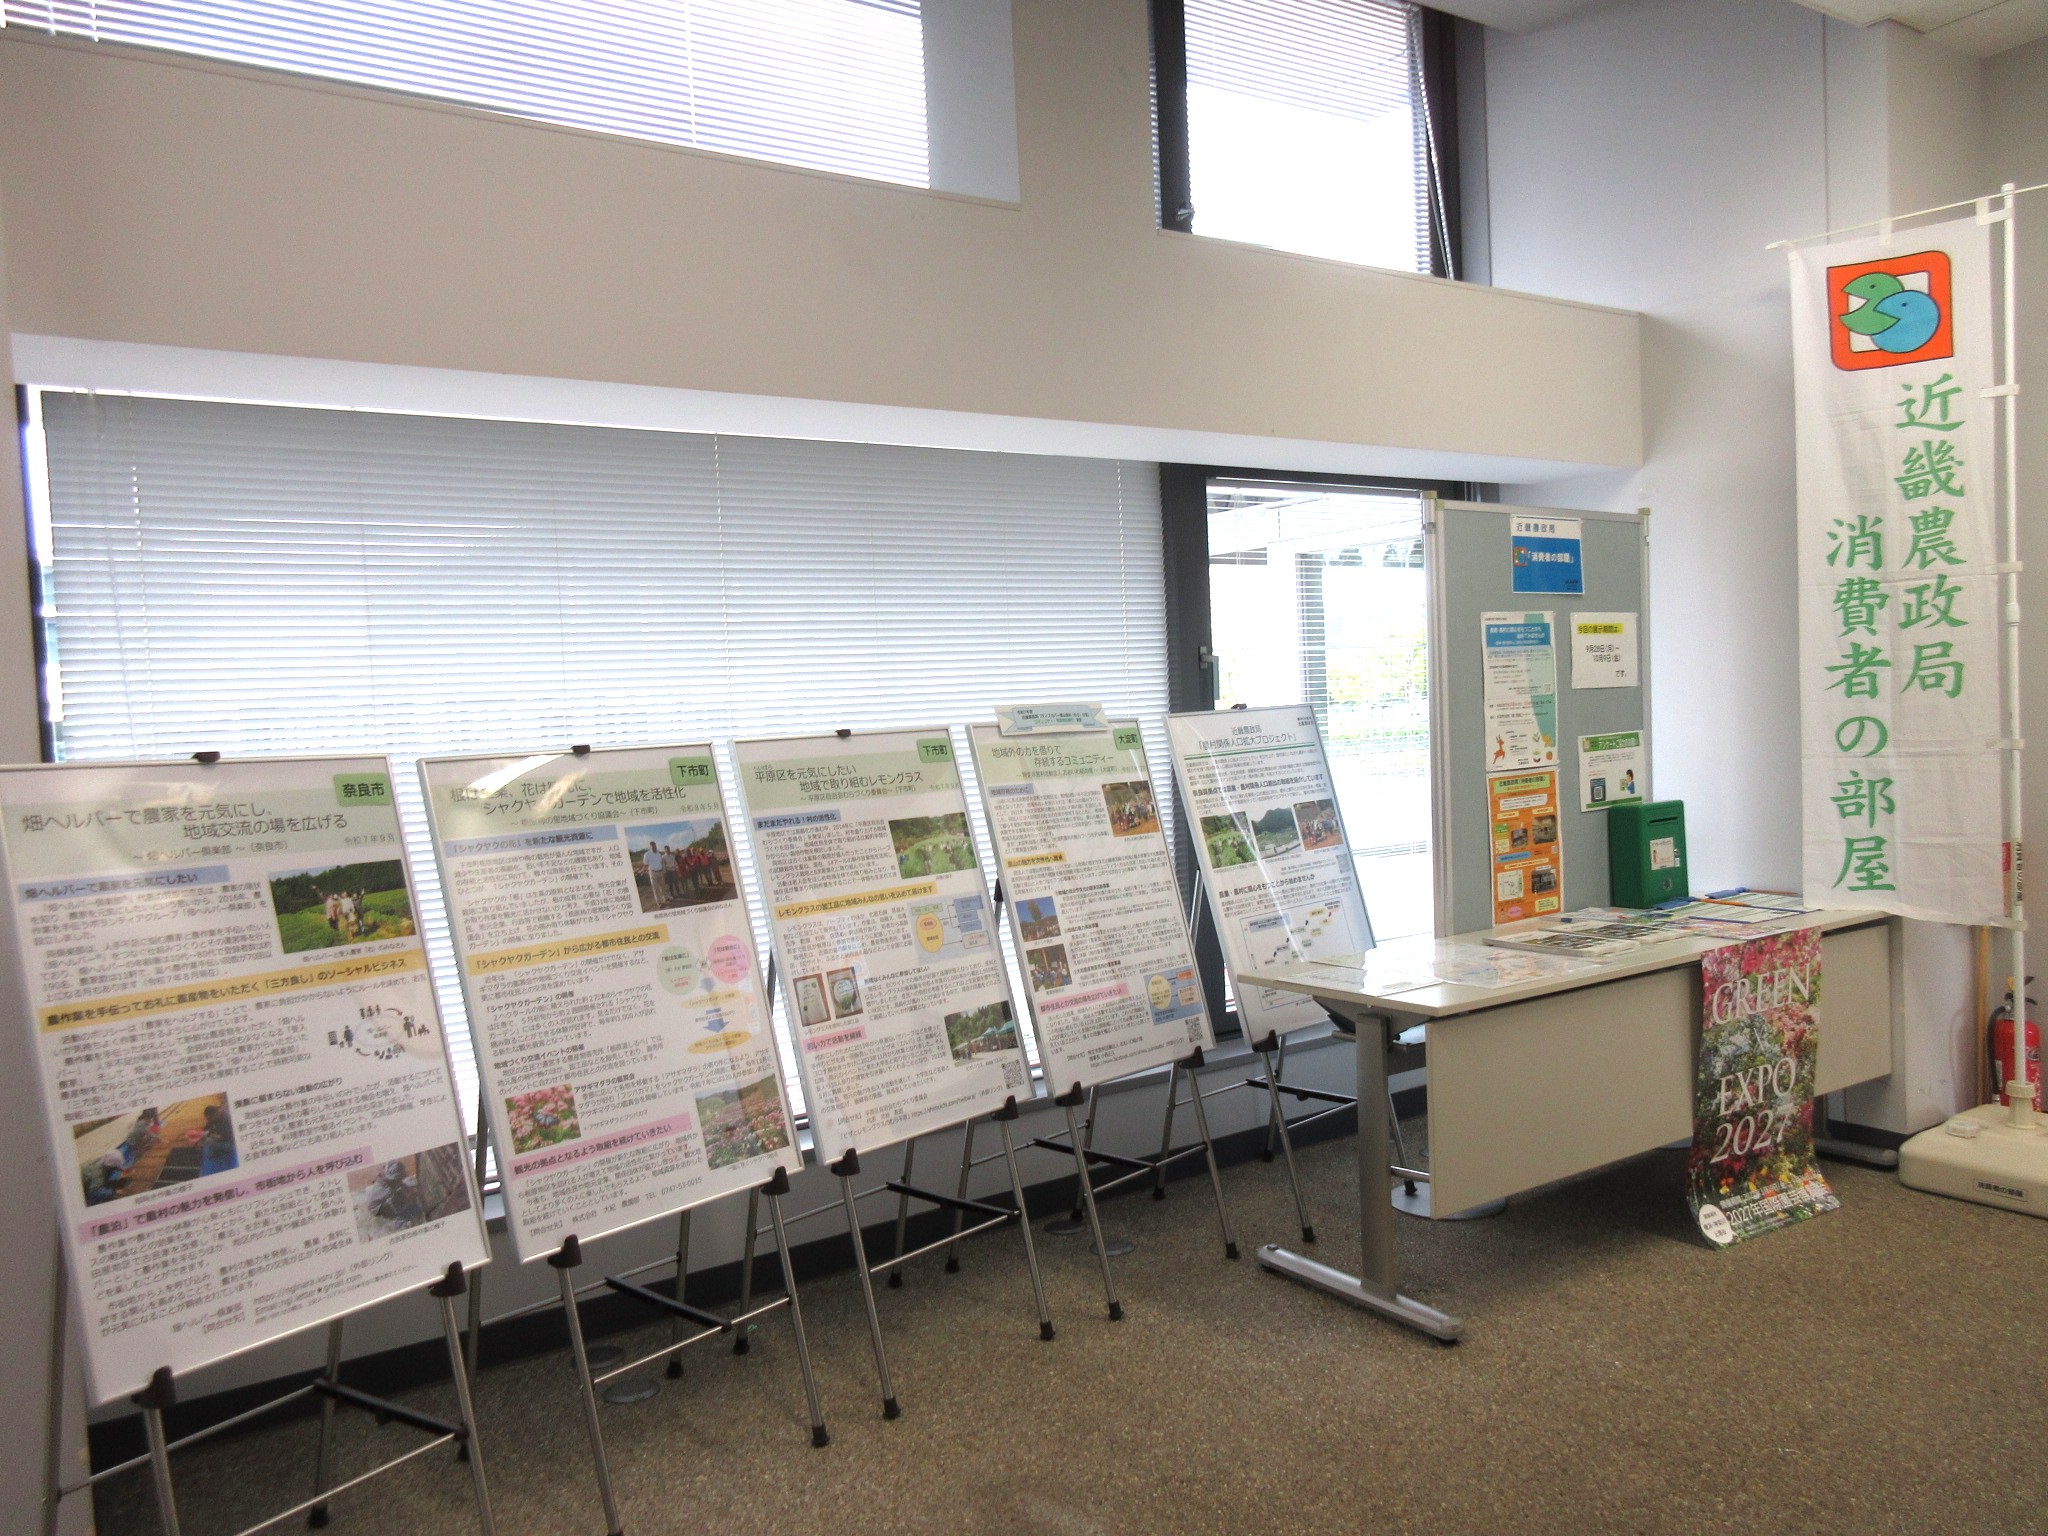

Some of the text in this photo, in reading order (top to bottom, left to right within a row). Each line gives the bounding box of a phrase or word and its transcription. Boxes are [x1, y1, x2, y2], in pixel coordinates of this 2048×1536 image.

[1893, 372, 1969, 699] 近畿農政局
[1824, 513, 1897, 892] 消費者の部屋
[922, 743, 948, 756] 下市町
[1117, 734, 1138, 743] 大淀町
[991, 744, 1062, 758] 地域外の力を借りて
[1033, 753, 1115, 768] 存続するコミュニティー
[676, 764, 709, 777] 下市町
[754, 763, 856, 783] 平原区を元気にしたい
[798, 770, 923, 793] 地域で取り組むレモングラス
[341, 782, 385, 797] 奈良市
[481, 785, 687, 815] シャクヤガーデンで地域を活性化
[21, 802, 273, 832] 畑ヘルパーで農家を元気にし、
[182, 814, 348, 839] 地域交流の場を広げる
[1712, 962, 1811, 1025] GREEN
[1716, 1057, 1797, 1117] EXPO
[1710, 1103, 1795, 1164] 2027
